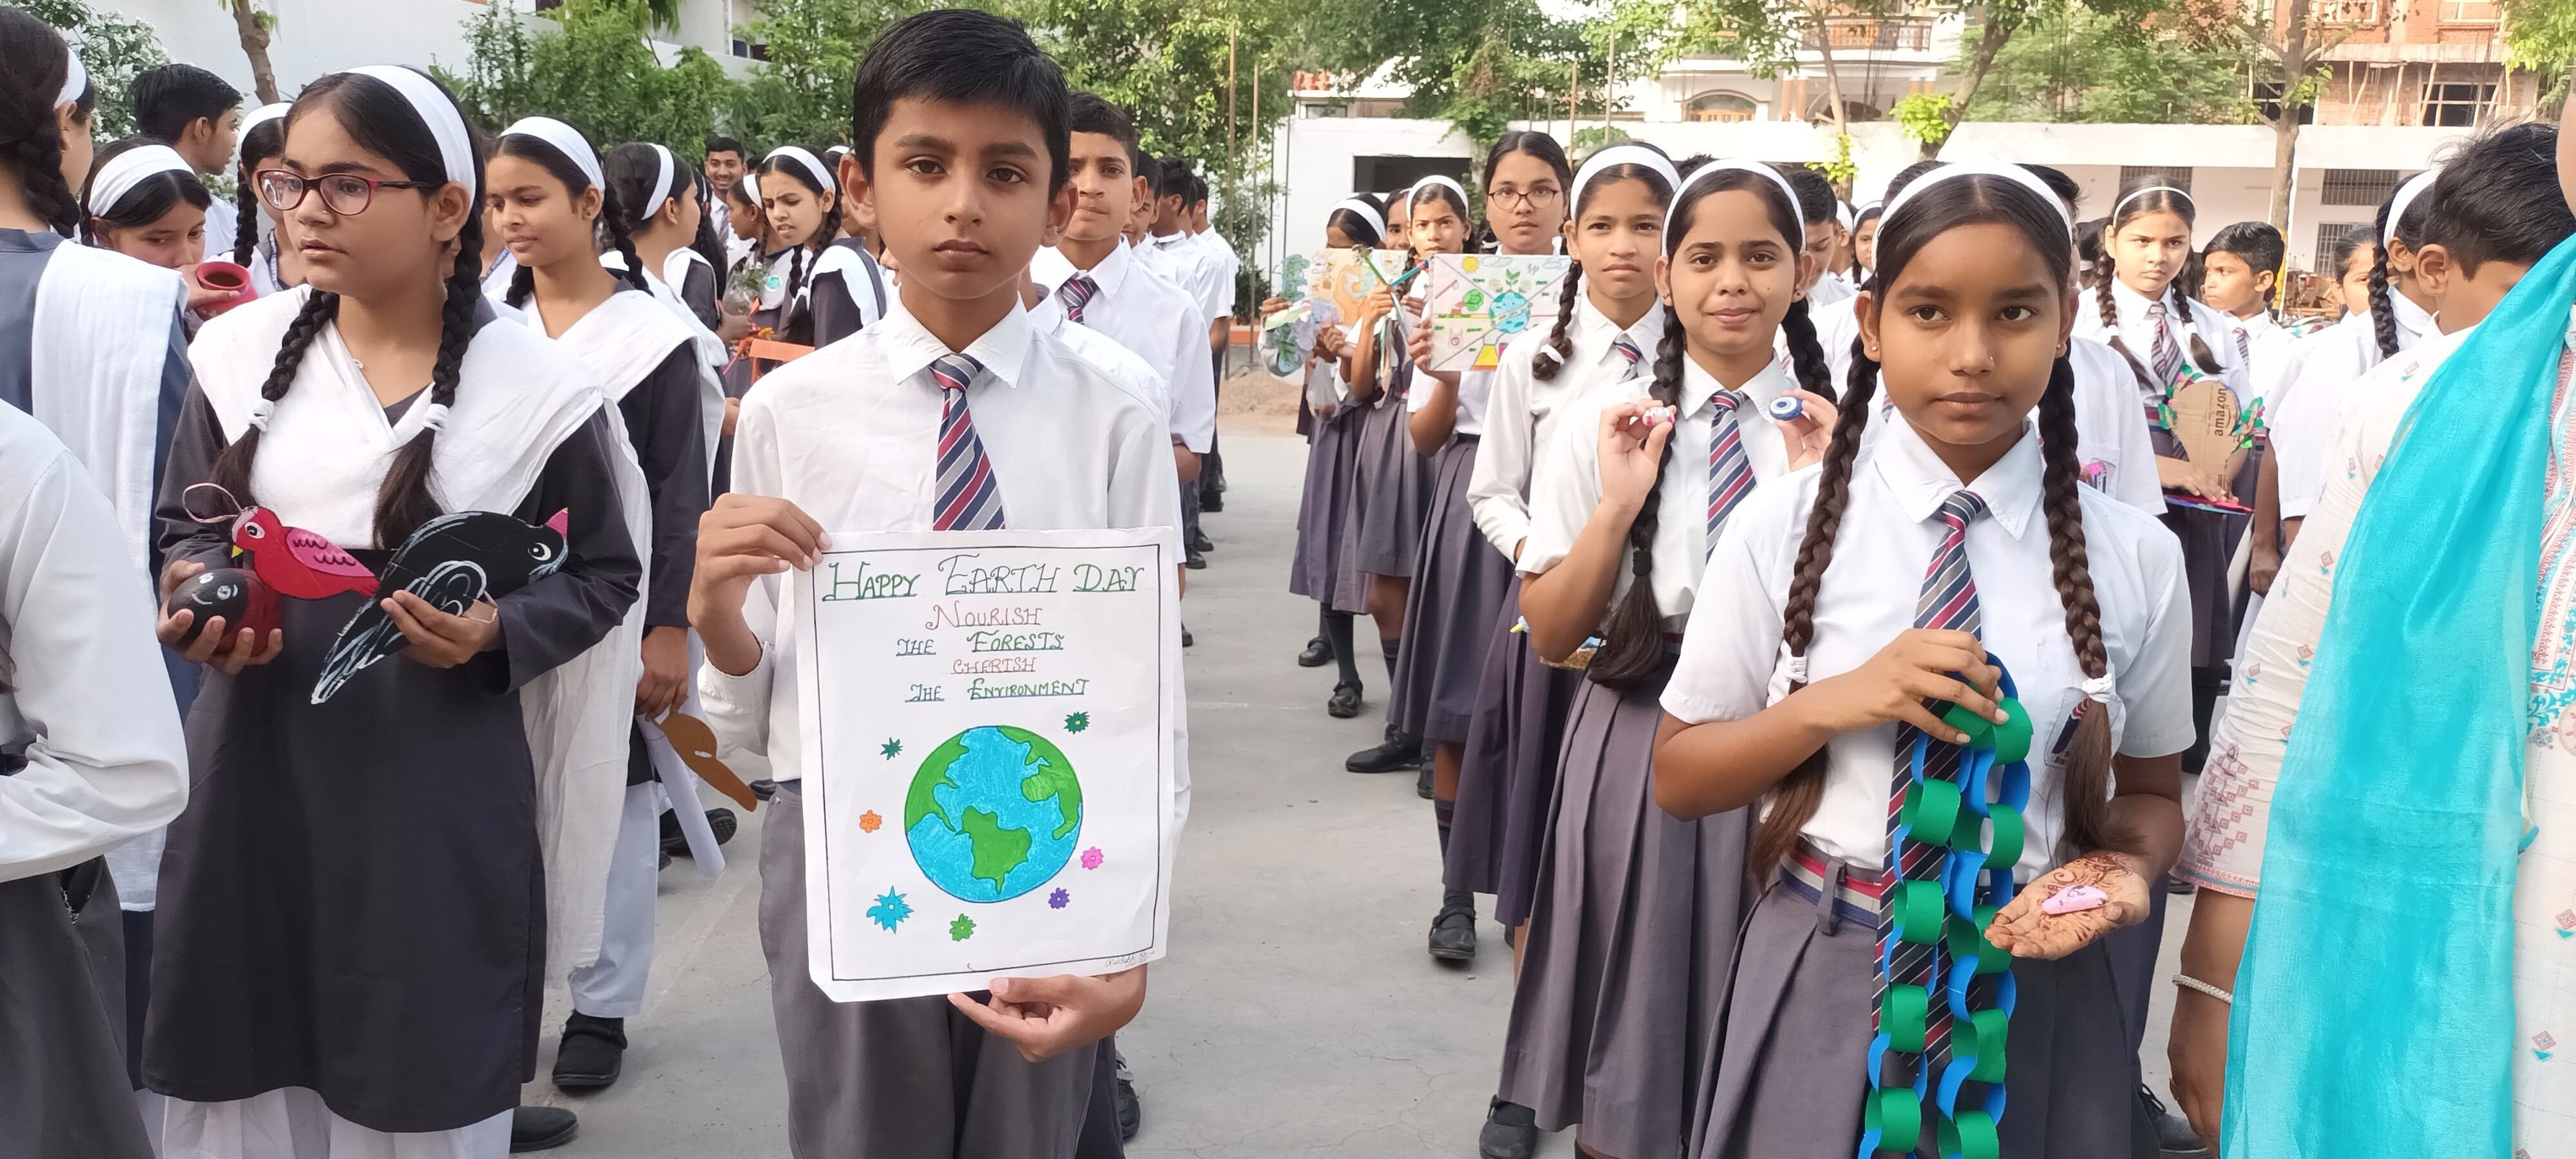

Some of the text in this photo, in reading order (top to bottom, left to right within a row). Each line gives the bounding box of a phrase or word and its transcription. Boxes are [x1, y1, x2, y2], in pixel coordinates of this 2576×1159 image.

[2214, 388, 2227, 436] amazon
[822, 553, 1145, 601] HAPPY EARTH DAY
[925, 600, 1043, 630] NOURISH
[896, 630, 1065, 656] THE FORESTS
[952, 657, 1037, 674] CHERISH
[905, 678, 1090, 702] THE ENVIRONMENT
